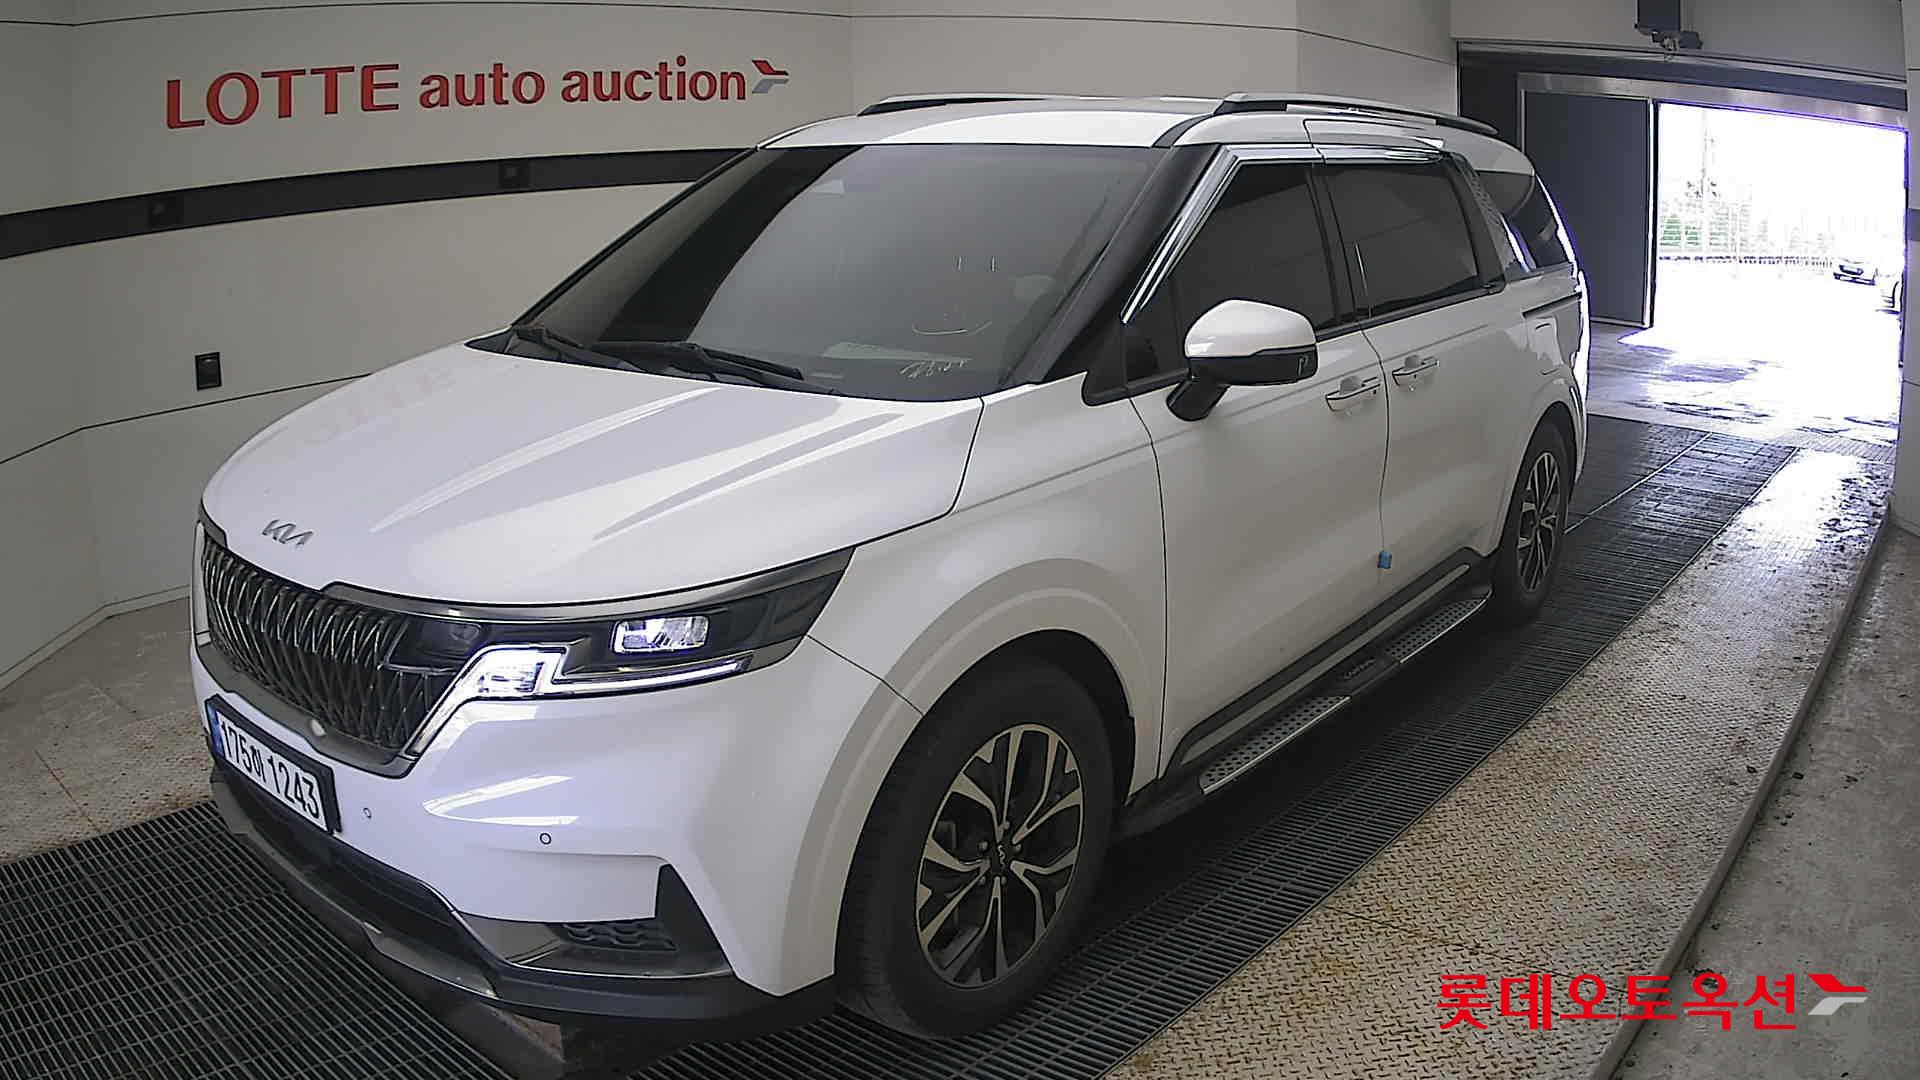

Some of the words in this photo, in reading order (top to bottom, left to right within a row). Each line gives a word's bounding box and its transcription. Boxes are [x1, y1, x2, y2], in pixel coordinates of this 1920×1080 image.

[166, 63, 400, 129] LOTTE
[419, 62, 546, 108] auto
[561, 55, 747, 103] auction
[267, 755, 320, 819] 1243
